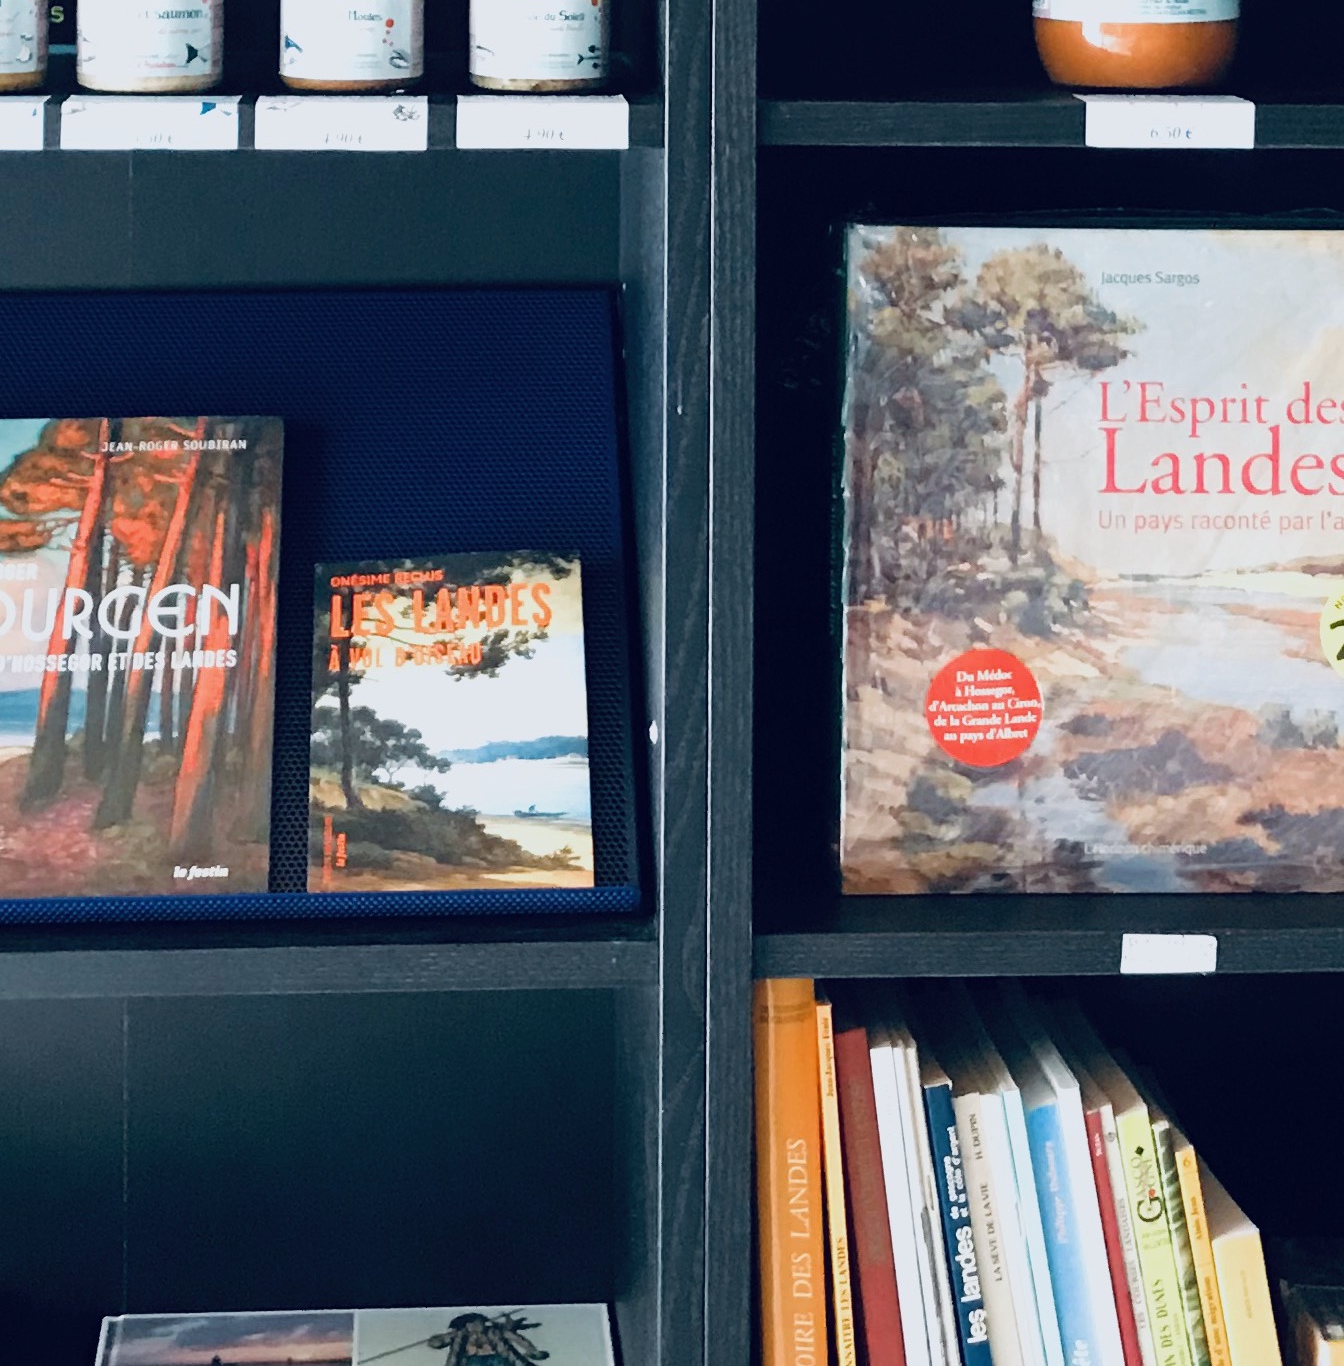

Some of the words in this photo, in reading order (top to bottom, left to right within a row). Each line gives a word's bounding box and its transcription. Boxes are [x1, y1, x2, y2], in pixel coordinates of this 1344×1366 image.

[1100, 271, 1152, 286] Jacques
[1154, 271, 1200, 286] Sargos
[1098, 381, 1270, 438] L'Esprit
[102, 440, 178, 452] JEAN-ROGER
[183, 438, 248, 451] SOUBIRAN
[1098, 510, 1127, 531] Un
[1134, 514, 1184, 535] pays
[1191, 509, 1272, 531] raconté
[1278, 514, 1314, 535] par
[329, 591, 395, 639] LES
[412, 582, 553, 634] LANDES
[107, 651, 129, 671] ET
[131, 651, 166, 670] DES
[170, 649, 239, 670] LANDES
[328, 643, 341, 672] À
[348, 645, 384, 669] VOL
[956, 670, 975, 683] Du
[977, 668, 1013, 682] Médoc
[933, 714, 947, 727] de
[949, 714, 960, 727] la
[961, 713, 1002, 726] Grande
[1004, 710, 1037, 725] Lande
[991, 701, 1005, 710] au
[943, 732, 958, 741] au
[959, 732, 984, 744] pays
[968, 1113, 982, 1149] DUPIN
[786, 1137, 810, 1239] LANDES
[791, 1251, 813, 1300] DES
[954, 1224, 982, 1303] landes
[966, 1307, 988, 1345] les
